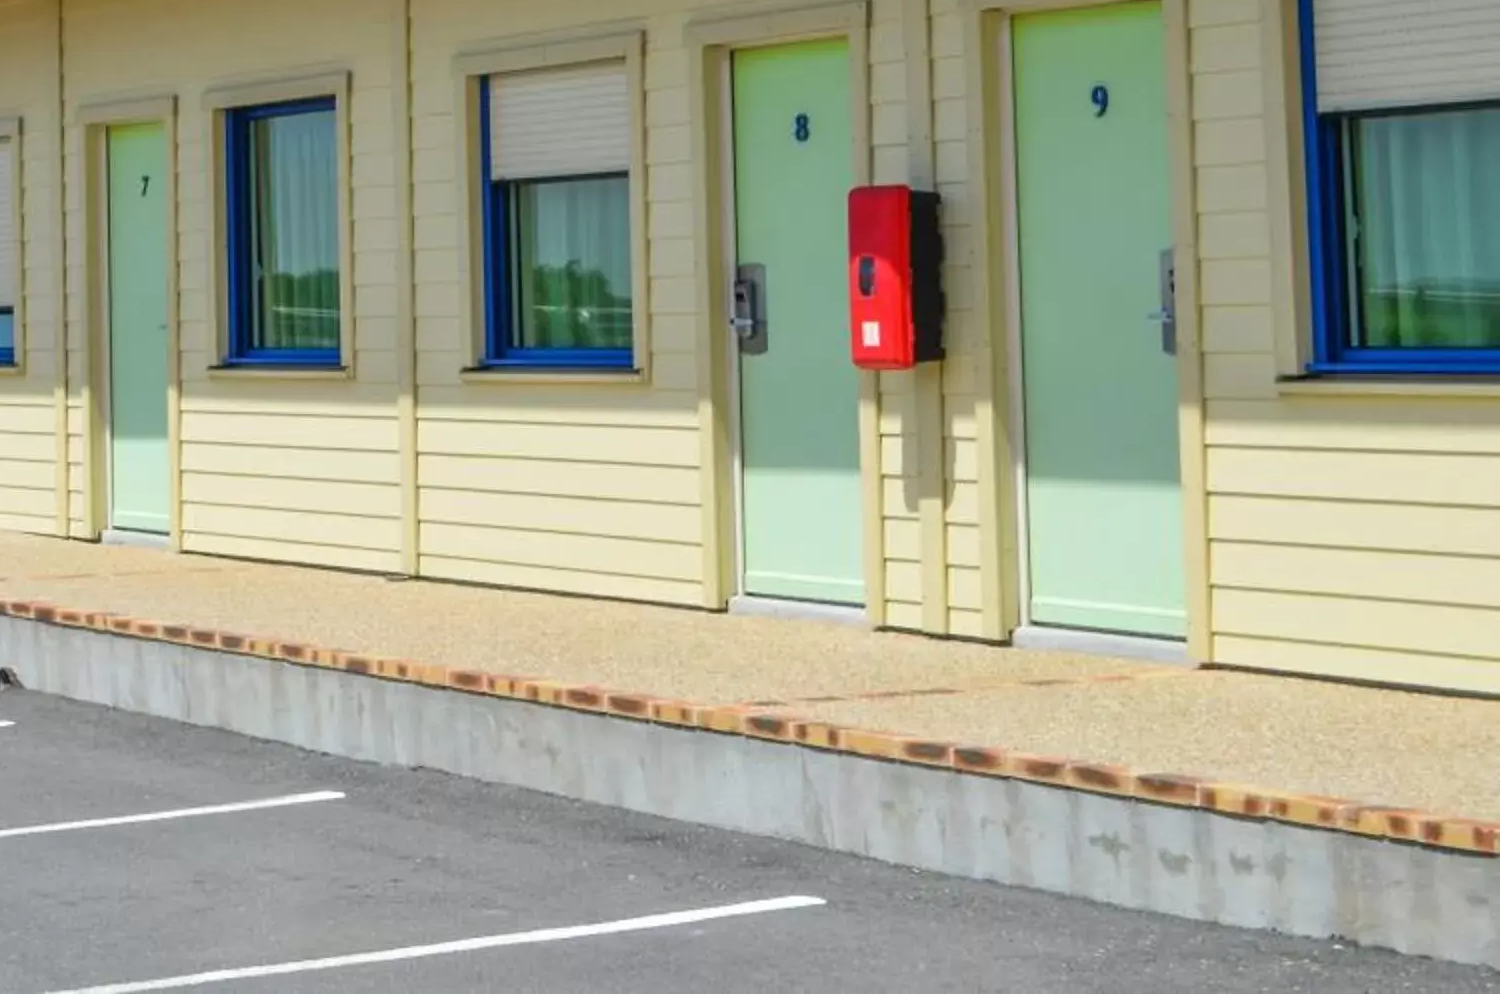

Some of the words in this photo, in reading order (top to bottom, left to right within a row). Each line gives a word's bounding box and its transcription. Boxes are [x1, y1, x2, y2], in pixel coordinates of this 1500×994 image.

[1091, 85, 1109, 118] 9
[795, 113, 810, 142] 8
[141, 174, 150, 197] 7
